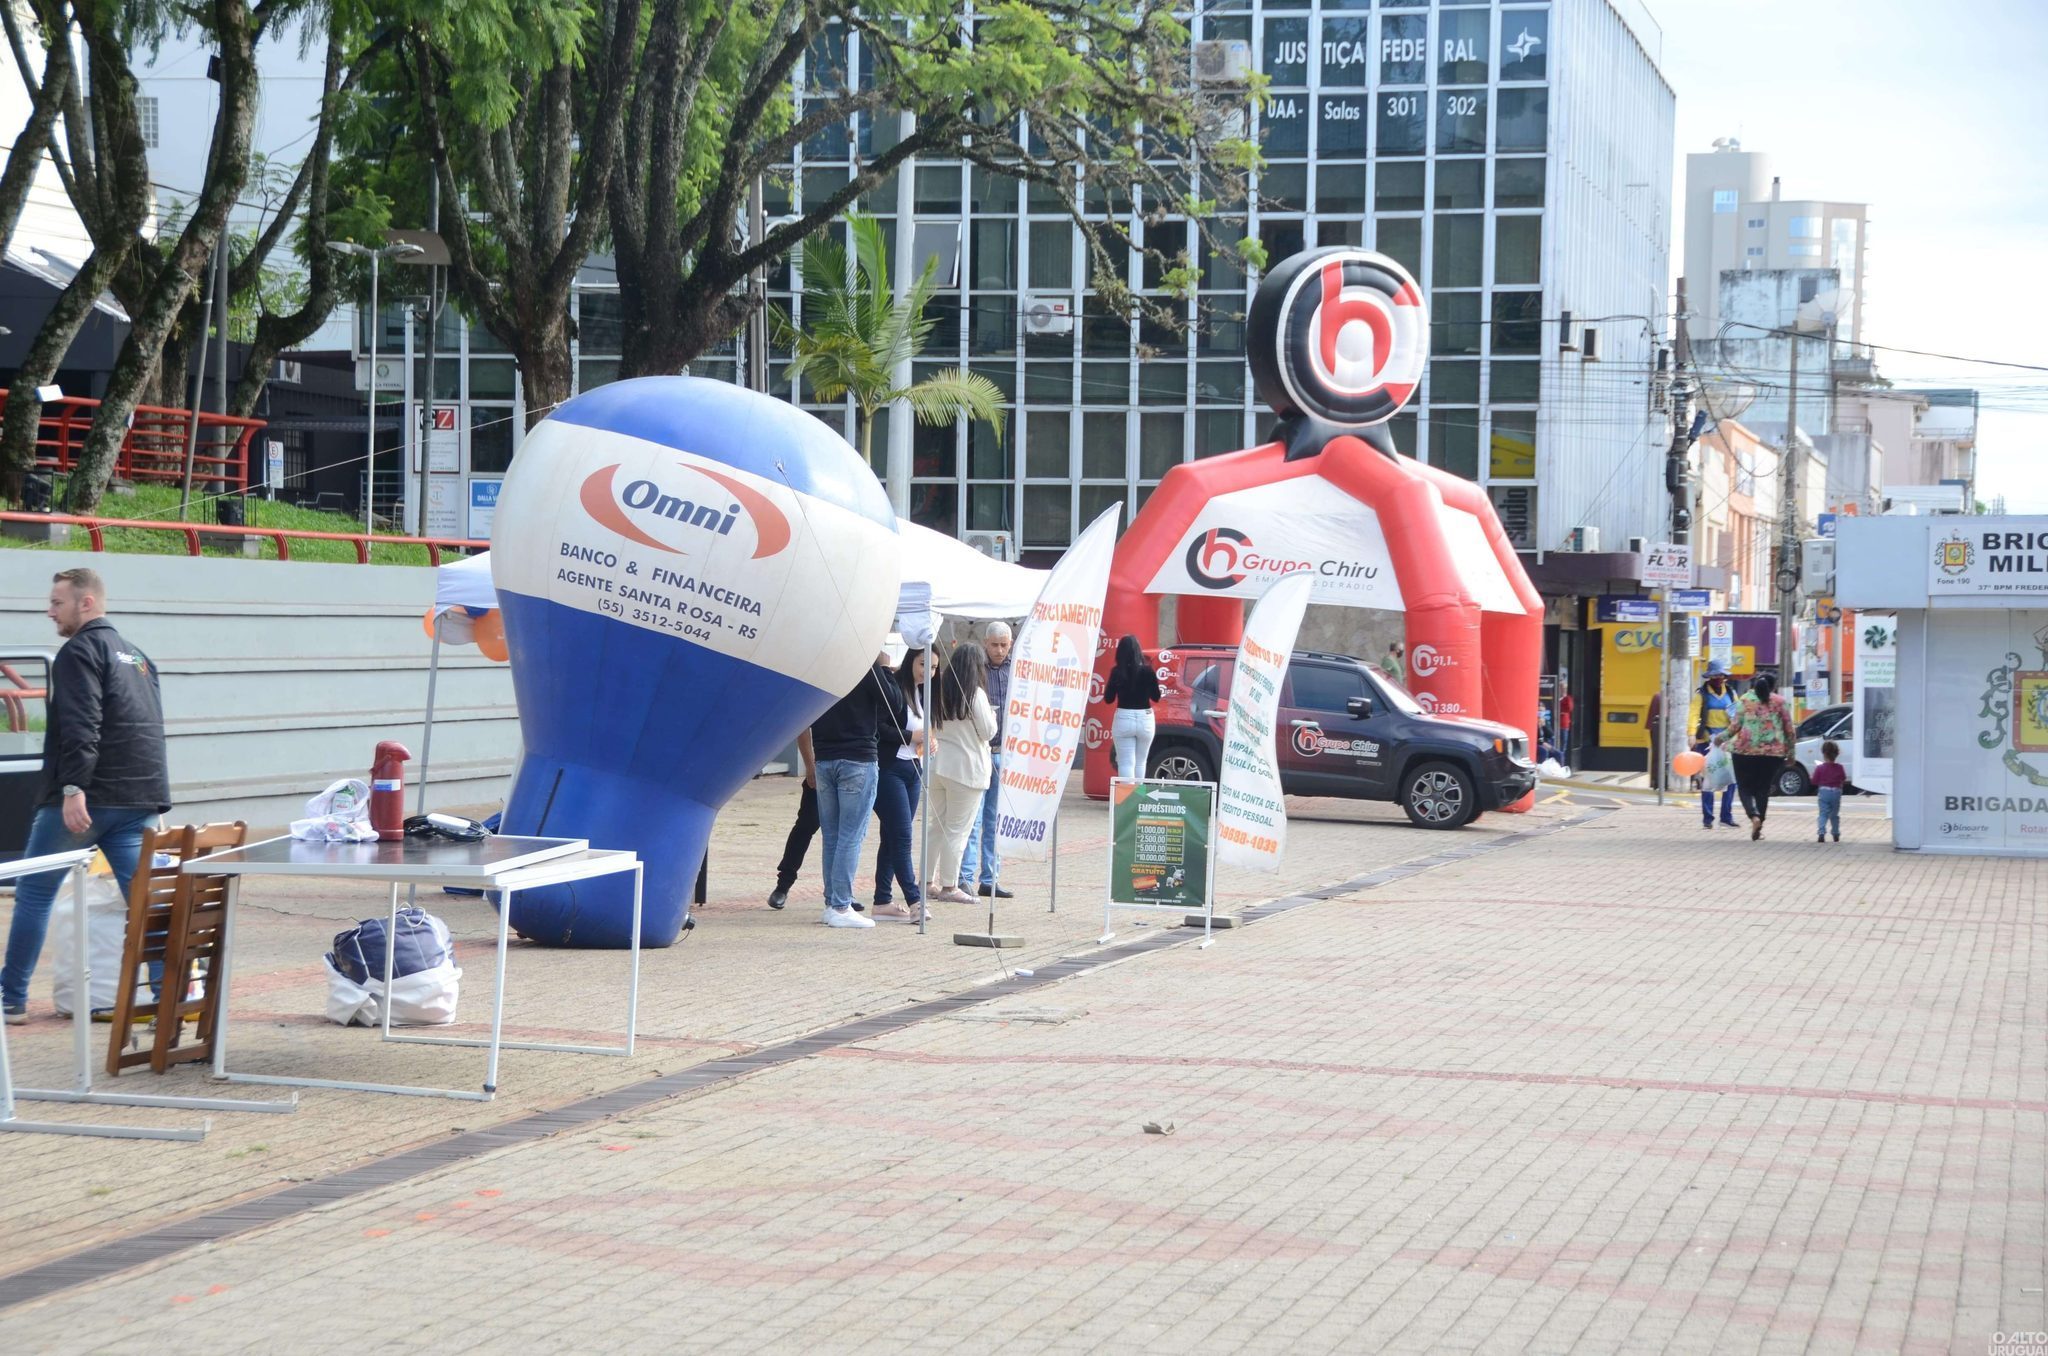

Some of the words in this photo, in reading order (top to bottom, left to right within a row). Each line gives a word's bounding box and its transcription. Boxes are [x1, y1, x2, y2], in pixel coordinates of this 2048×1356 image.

[1324, 101, 1361, 121] Salas
[1386, 97, 1418, 117] 301
[1446, 97, 1477, 117] 302
[621, 479, 742, 536] Omni
[559, 542, 617, 569] BANCO
[625, 560, 638, 577] &
[651, 566, 763, 617] FINANCEIRA
[1319, 560, 1378, 580] Chiru
[556, 567, 613, 594] AGENTE
[618, 584, 672, 611] SANTA
[677, 601, 723, 628] ROSA
[737, 622, 758, 641] RS
[597, 597, 625, 618] (55)
[631, 607, 711, 641] 3512-5044
[1051, 631, 1061, 654] E
[1009, 698, 1031, 718] DE
[1033, 705, 1082, 729] CARRO
[1005, 734, 1062, 763] MOTOS
[1317, 736, 1350, 750] Grupo
[1351, 739, 1380, 752] Chiru
[1138, 803, 1186, 814] EMPRÉSTIMOS
[1241, 792, 1264, 807] CONTA
[1265, 800, 1276, 810] DE
[1944, 795, 2048, 813] BRIGADA
